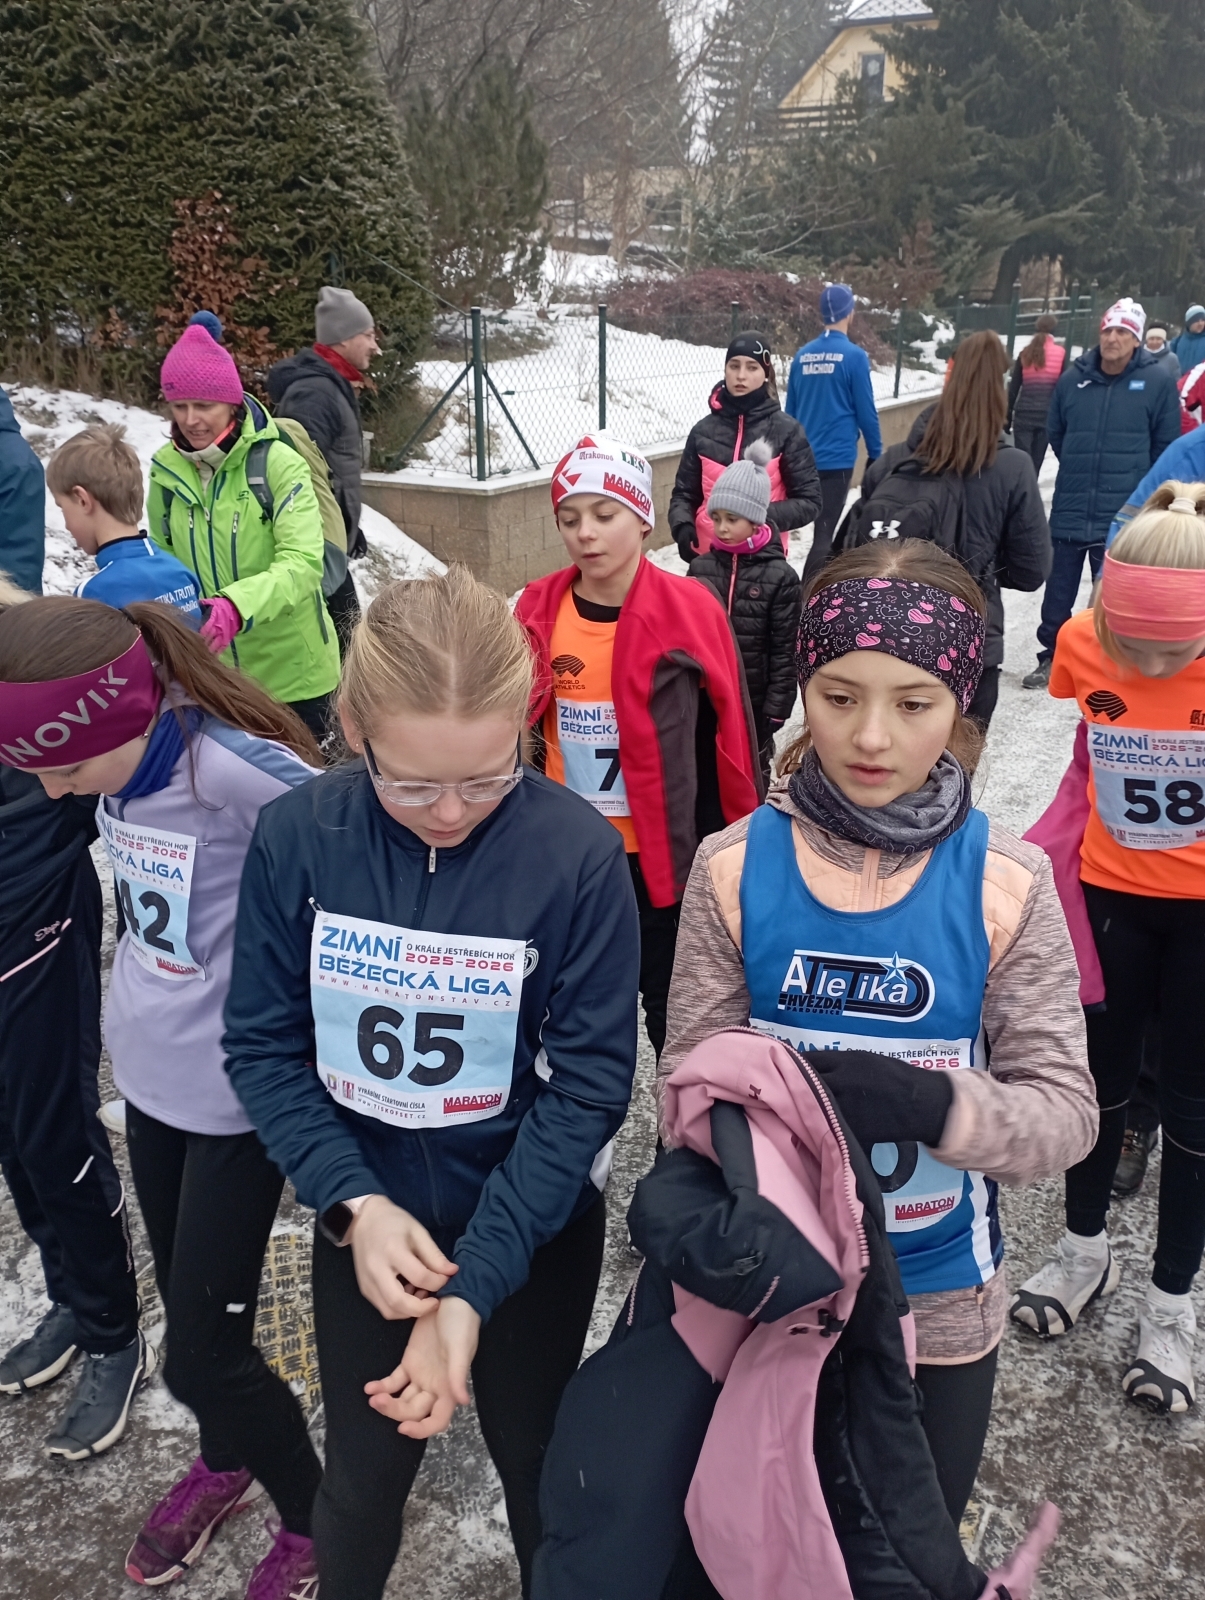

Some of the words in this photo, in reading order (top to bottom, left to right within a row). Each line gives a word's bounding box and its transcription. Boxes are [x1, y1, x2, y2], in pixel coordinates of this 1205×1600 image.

[603, 472, 651, 512] MARATON
[561, 706, 602, 721] ZIMNÍ
[1093, 731, 1148, 750] ZIMNÍ
[1093, 749, 1180, 767] BĚŽECKÁ
[1124, 778, 1205, 825] 58
[116, 834, 187, 860] 2025-2026
[137, 834, 172, 848] JESTŘEBÍCH
[174, 843, 188, 852] HOR
[142, 859, 184, 882] LIGA
[120, 879, 175, 955] 42
[320, 925, 402, 961] ZIMNÍ
[407, 943, 413, 951] O
[415, 945, 442, 954] KRÁLE
[444, 947, 494, 959] JESTŘEBÍCH
[406, 953, 514, 972] 2025-2026
[319, 953, 440, 990] BĚŽECKÁ
[449, 975, 512, 996] LIGA
[787, 1006, 840, 1015] PARDUBICE
[357, 1005, 464, 1086] 65
[444, 1093, 502, 1108] MARATON
[895, 1196, 955, 1214] MARATON
